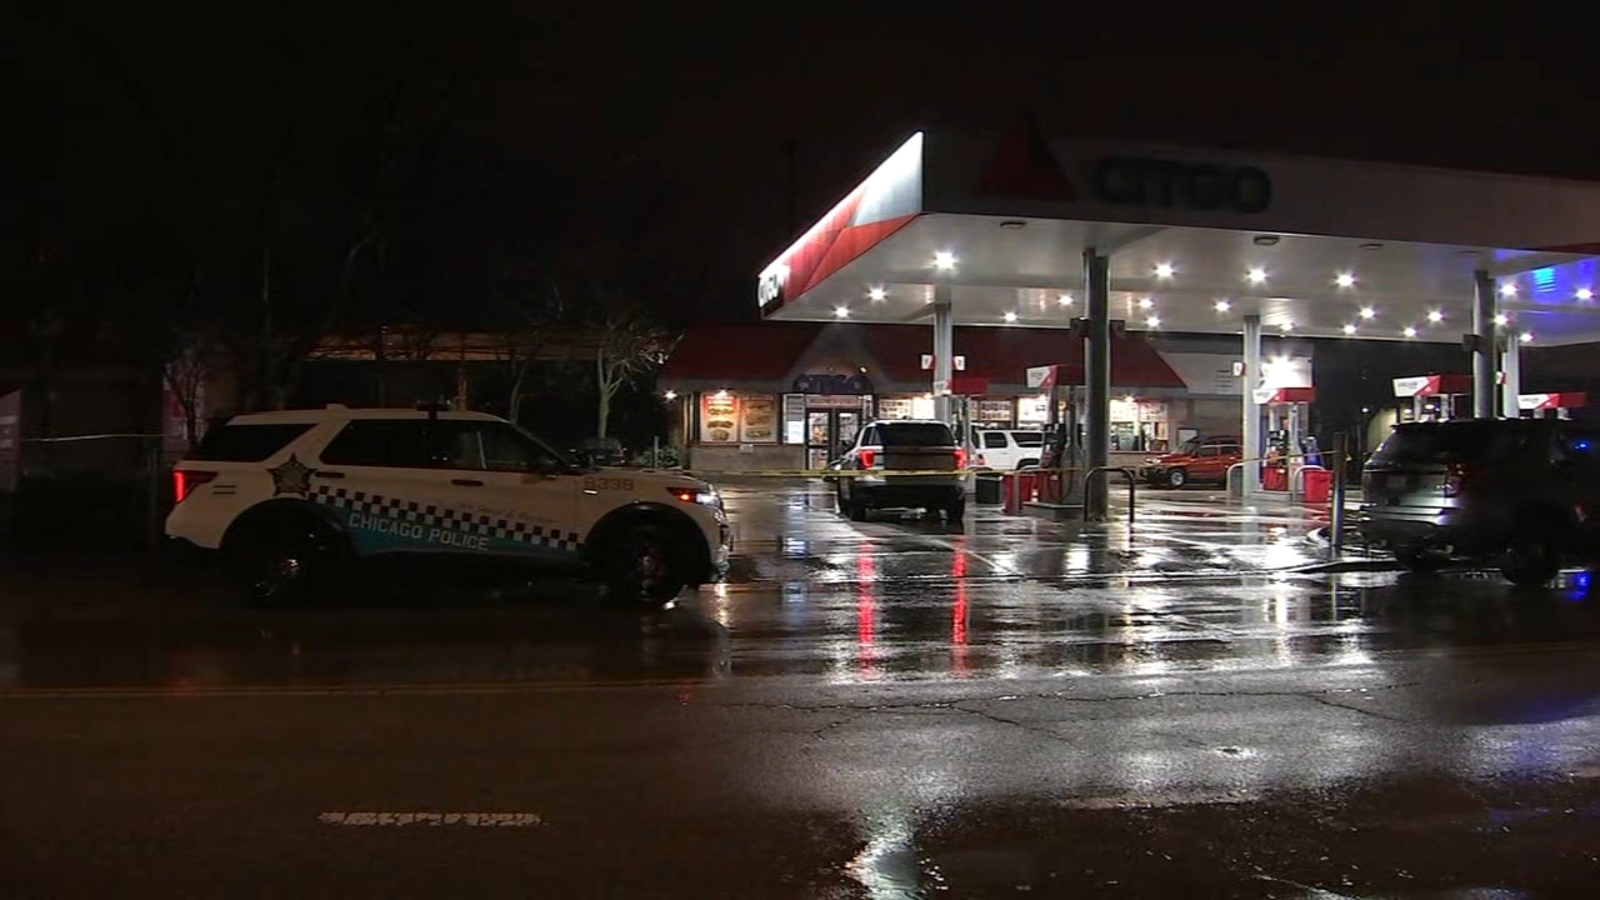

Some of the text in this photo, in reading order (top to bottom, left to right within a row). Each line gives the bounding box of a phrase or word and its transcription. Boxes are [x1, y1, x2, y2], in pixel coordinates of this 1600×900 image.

[1093, 157, 1273, 214] CITGO
[348, 512, 491, 553] CHICAGO POLICE
